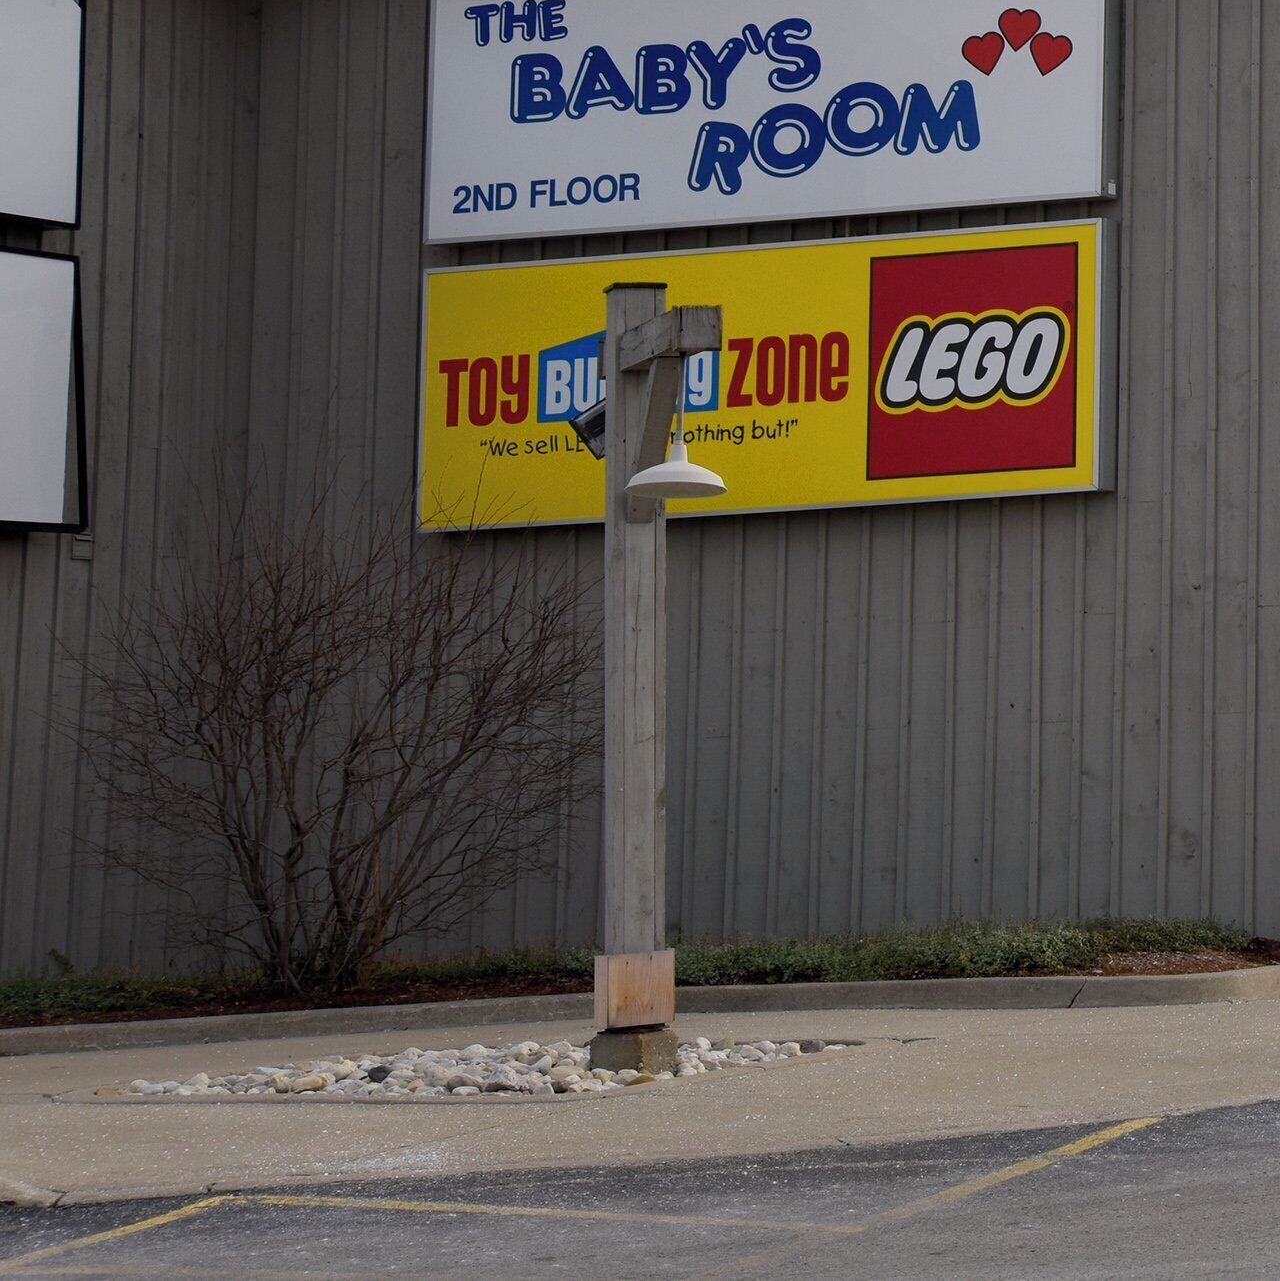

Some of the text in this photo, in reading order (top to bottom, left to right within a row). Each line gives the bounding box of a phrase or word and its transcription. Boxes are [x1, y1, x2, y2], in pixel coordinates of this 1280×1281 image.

[509, 17, 822, 124] BABY'S
[687, 78, 981, 196] ROOM
[452, 173, 641, 214] 2ND FLOOR
[880, 312, 1066, 408] LEGO
[524, 434, 559, 455] sell
